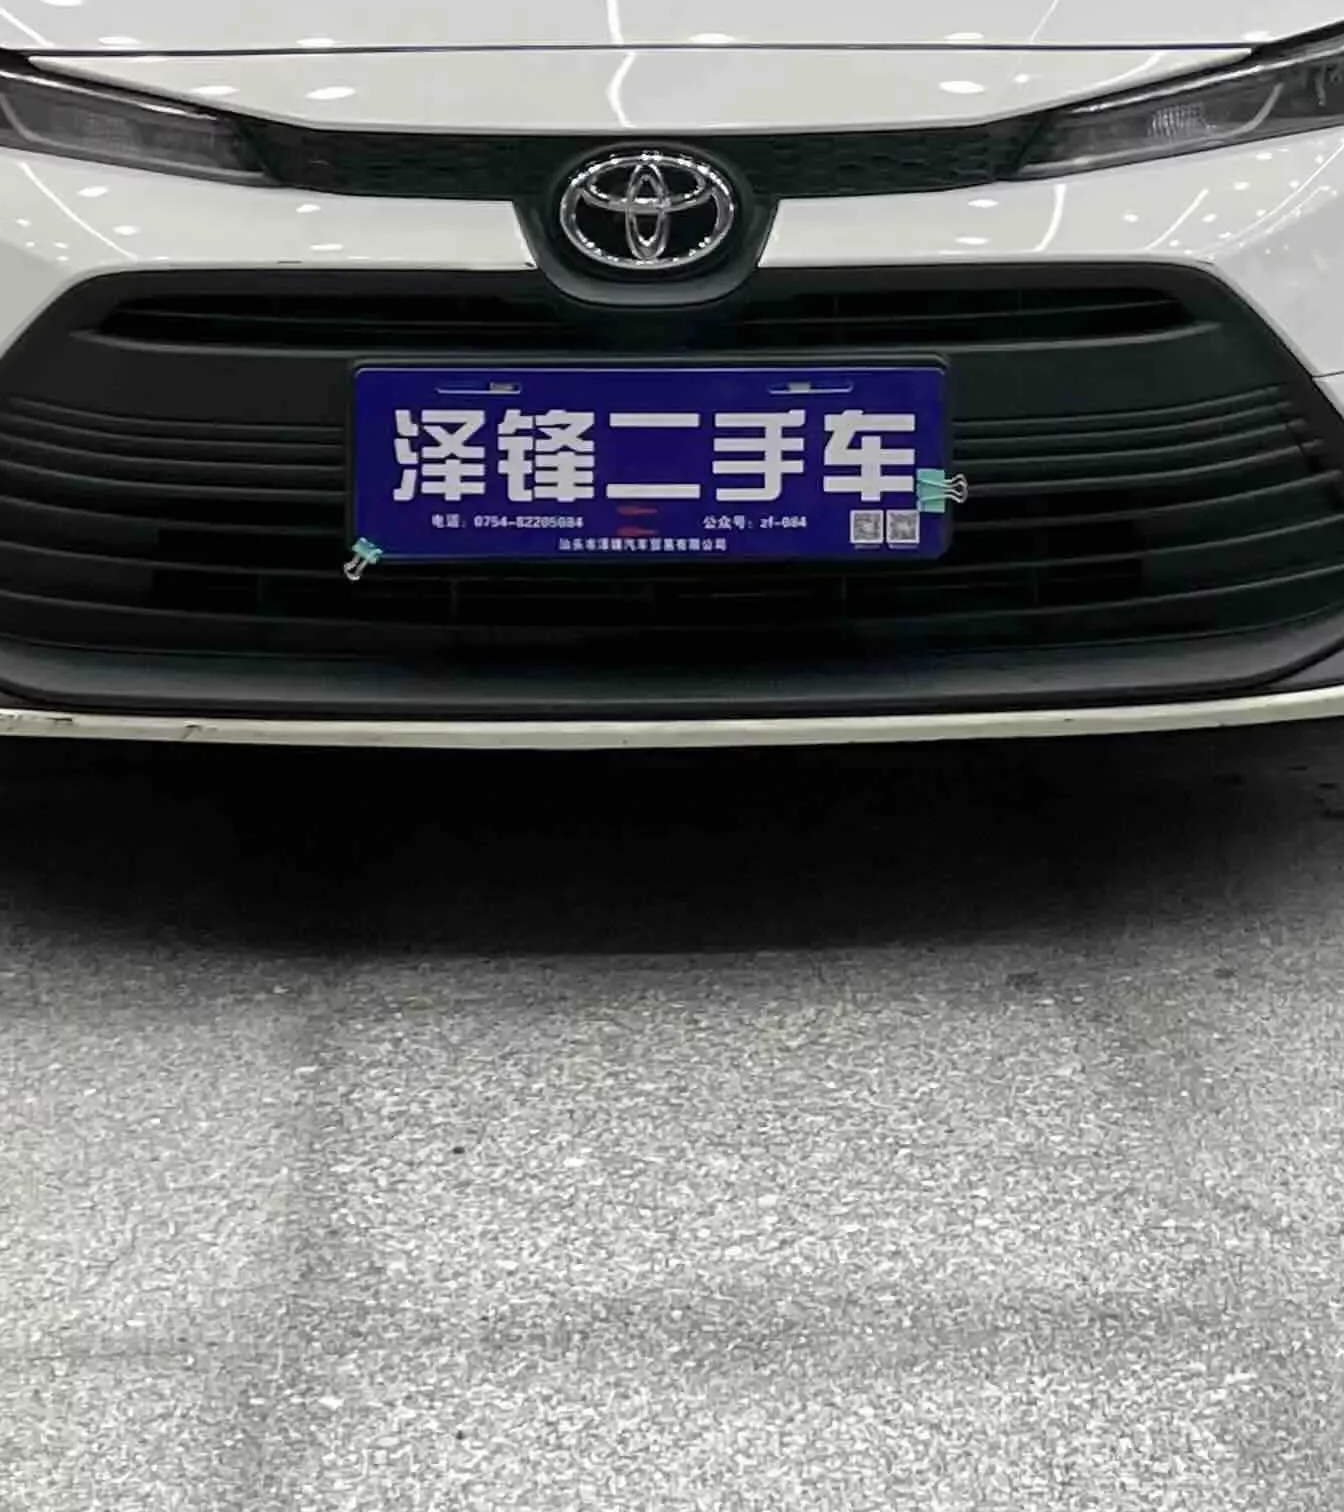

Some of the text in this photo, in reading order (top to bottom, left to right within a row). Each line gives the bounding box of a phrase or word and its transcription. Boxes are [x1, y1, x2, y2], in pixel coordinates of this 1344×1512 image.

[393, 409, 917, 502] 泽锋二手车
